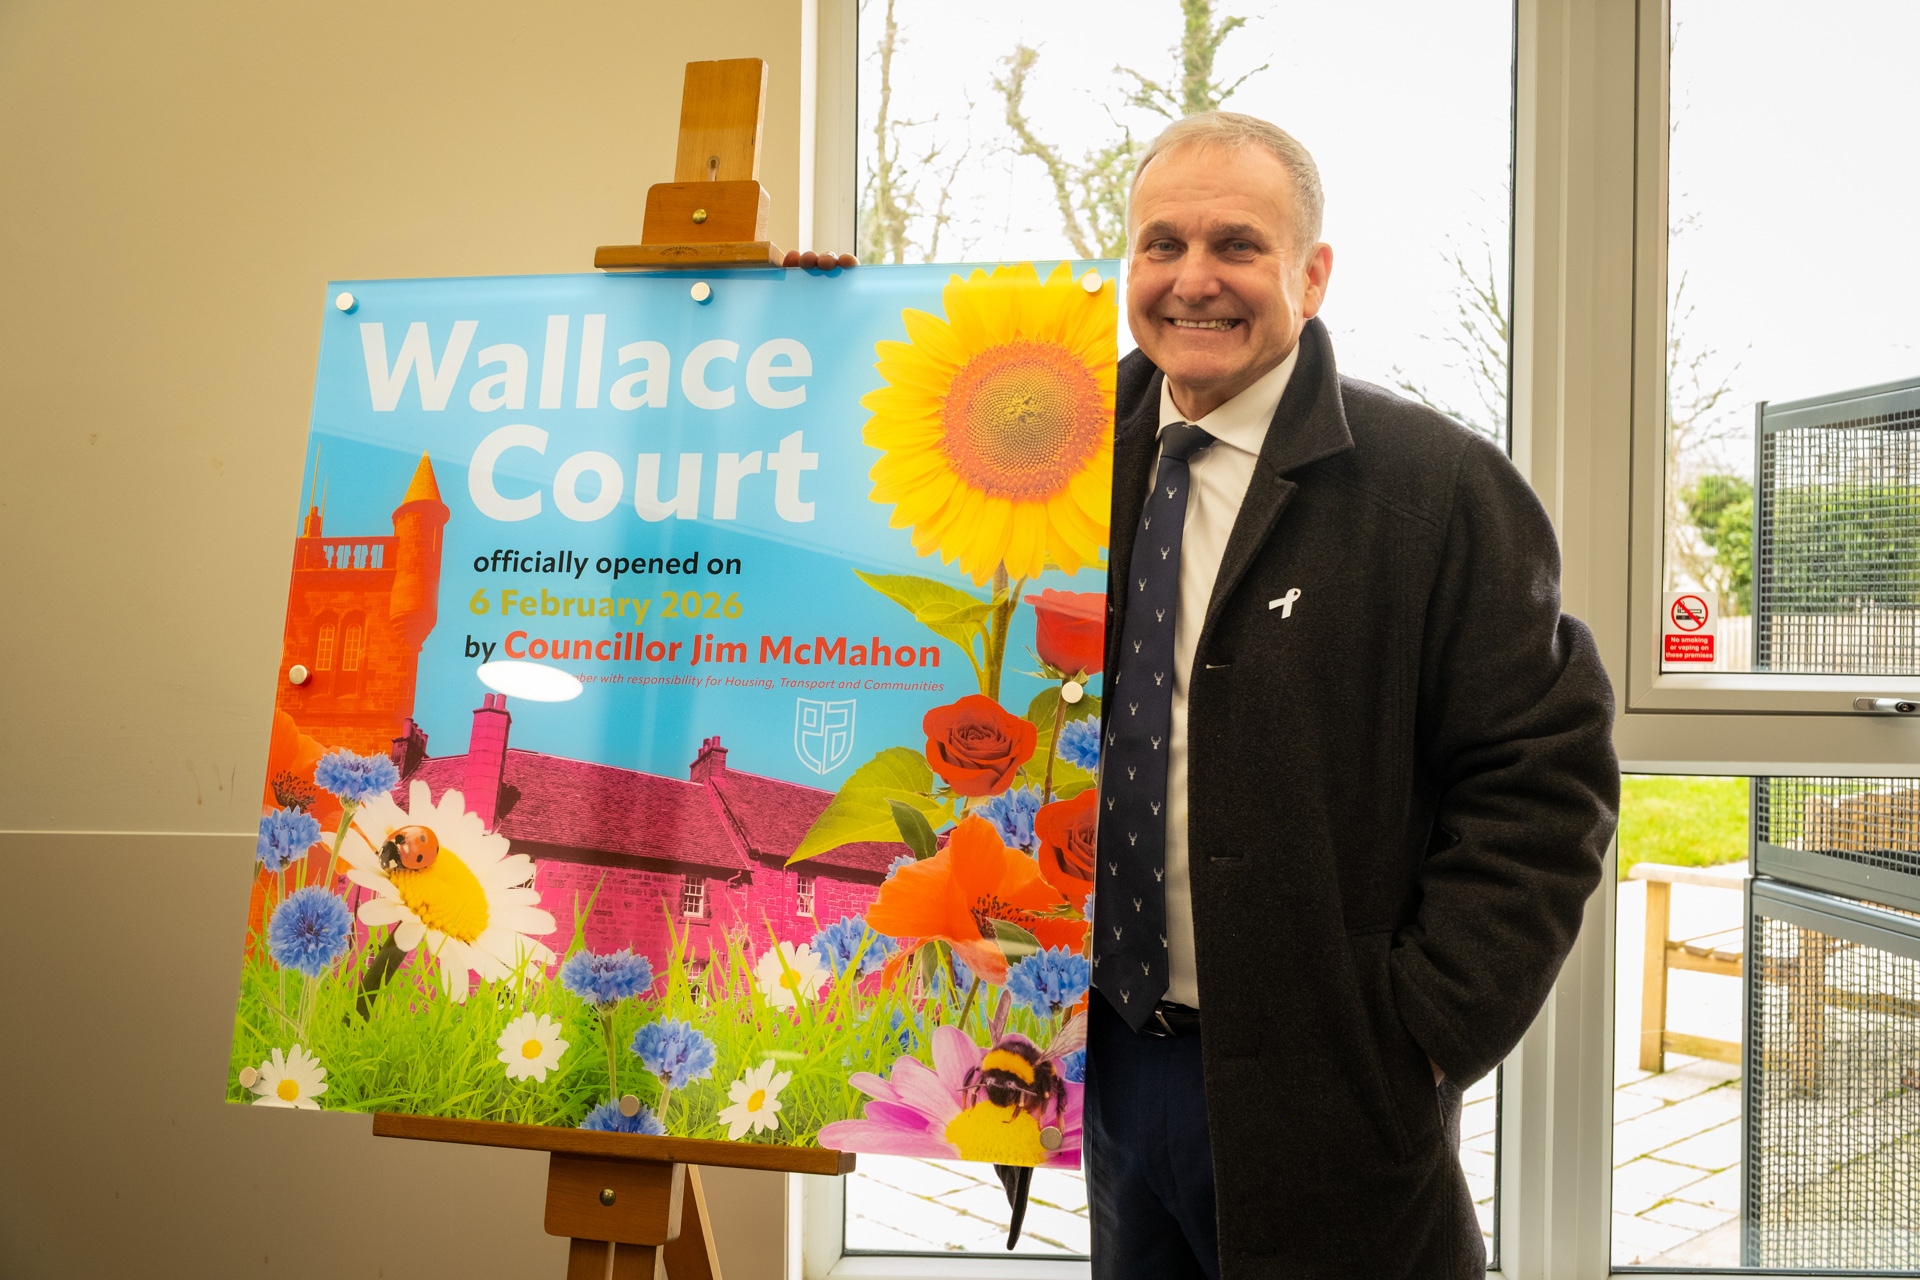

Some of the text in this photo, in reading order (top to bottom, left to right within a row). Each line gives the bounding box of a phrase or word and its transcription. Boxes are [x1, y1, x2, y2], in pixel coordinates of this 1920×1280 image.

[359, 313, 813, 412] Wallace
[468, 424, 819, 523] Court
[473, 549, 742, 580] officially opened on
[469, 588, 743, 626] 6 February 2026
[464, 630, 941, 668] by Councillor Jim McMahon
[600, 673, 624, 684] with
[626, 674, 703, 688] responsibility
[704, 675, 722, 688] for
[724, 676, 775, 690] Housing,
[780, 677, 835, 691] Transport
[837, 679, 861, 689] and
[863, 679, 945, 692] Communities
